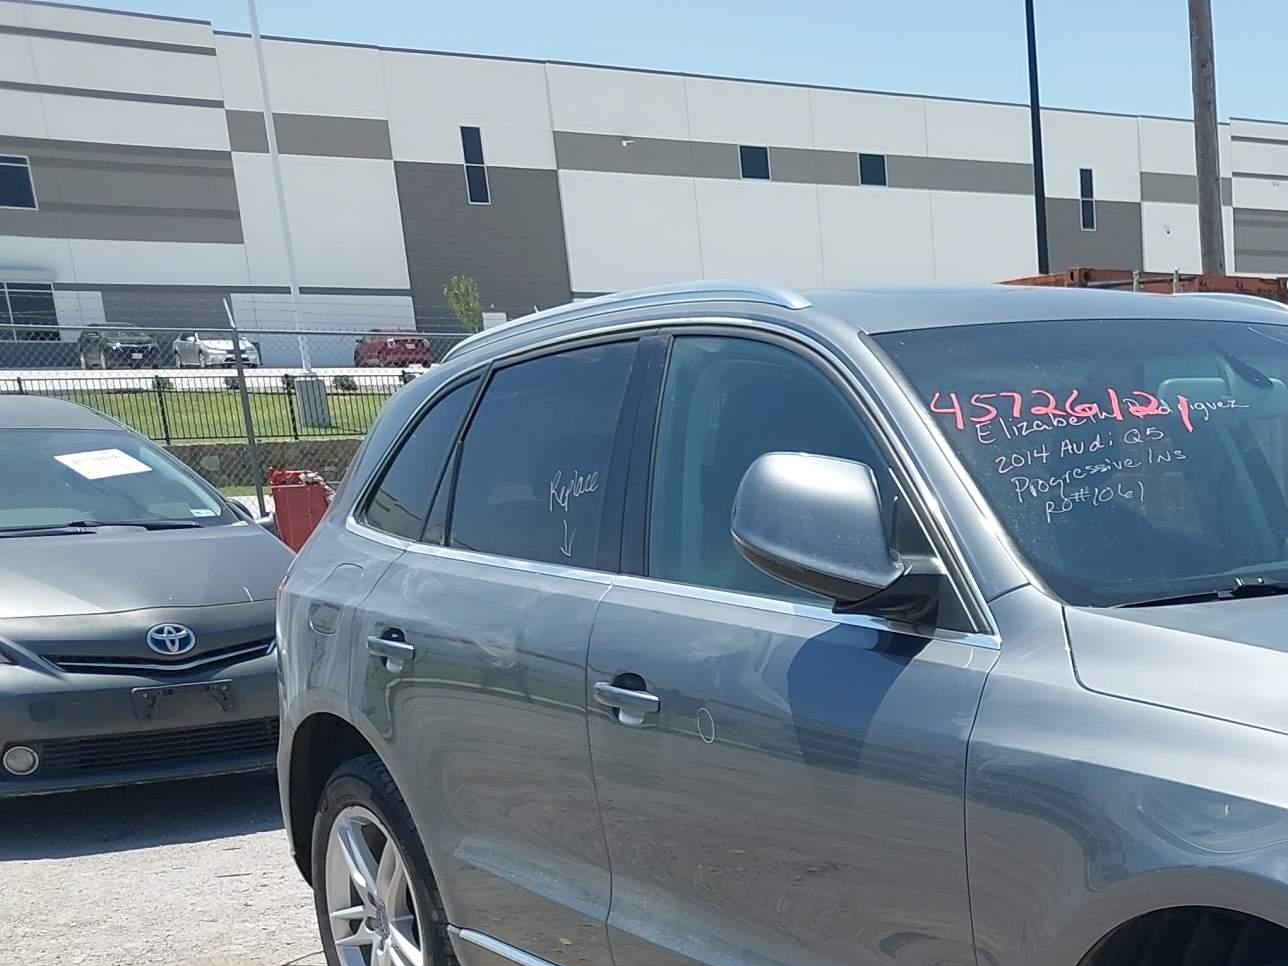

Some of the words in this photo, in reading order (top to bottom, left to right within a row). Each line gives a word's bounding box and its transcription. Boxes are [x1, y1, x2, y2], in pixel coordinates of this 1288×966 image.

[930, 389, 1194, 433] 45726121
[995, 444, 1050, 474] 2014
[1123, 427, 1165, 445] Q5
[1010, 459, 1142, 503] Progressive
